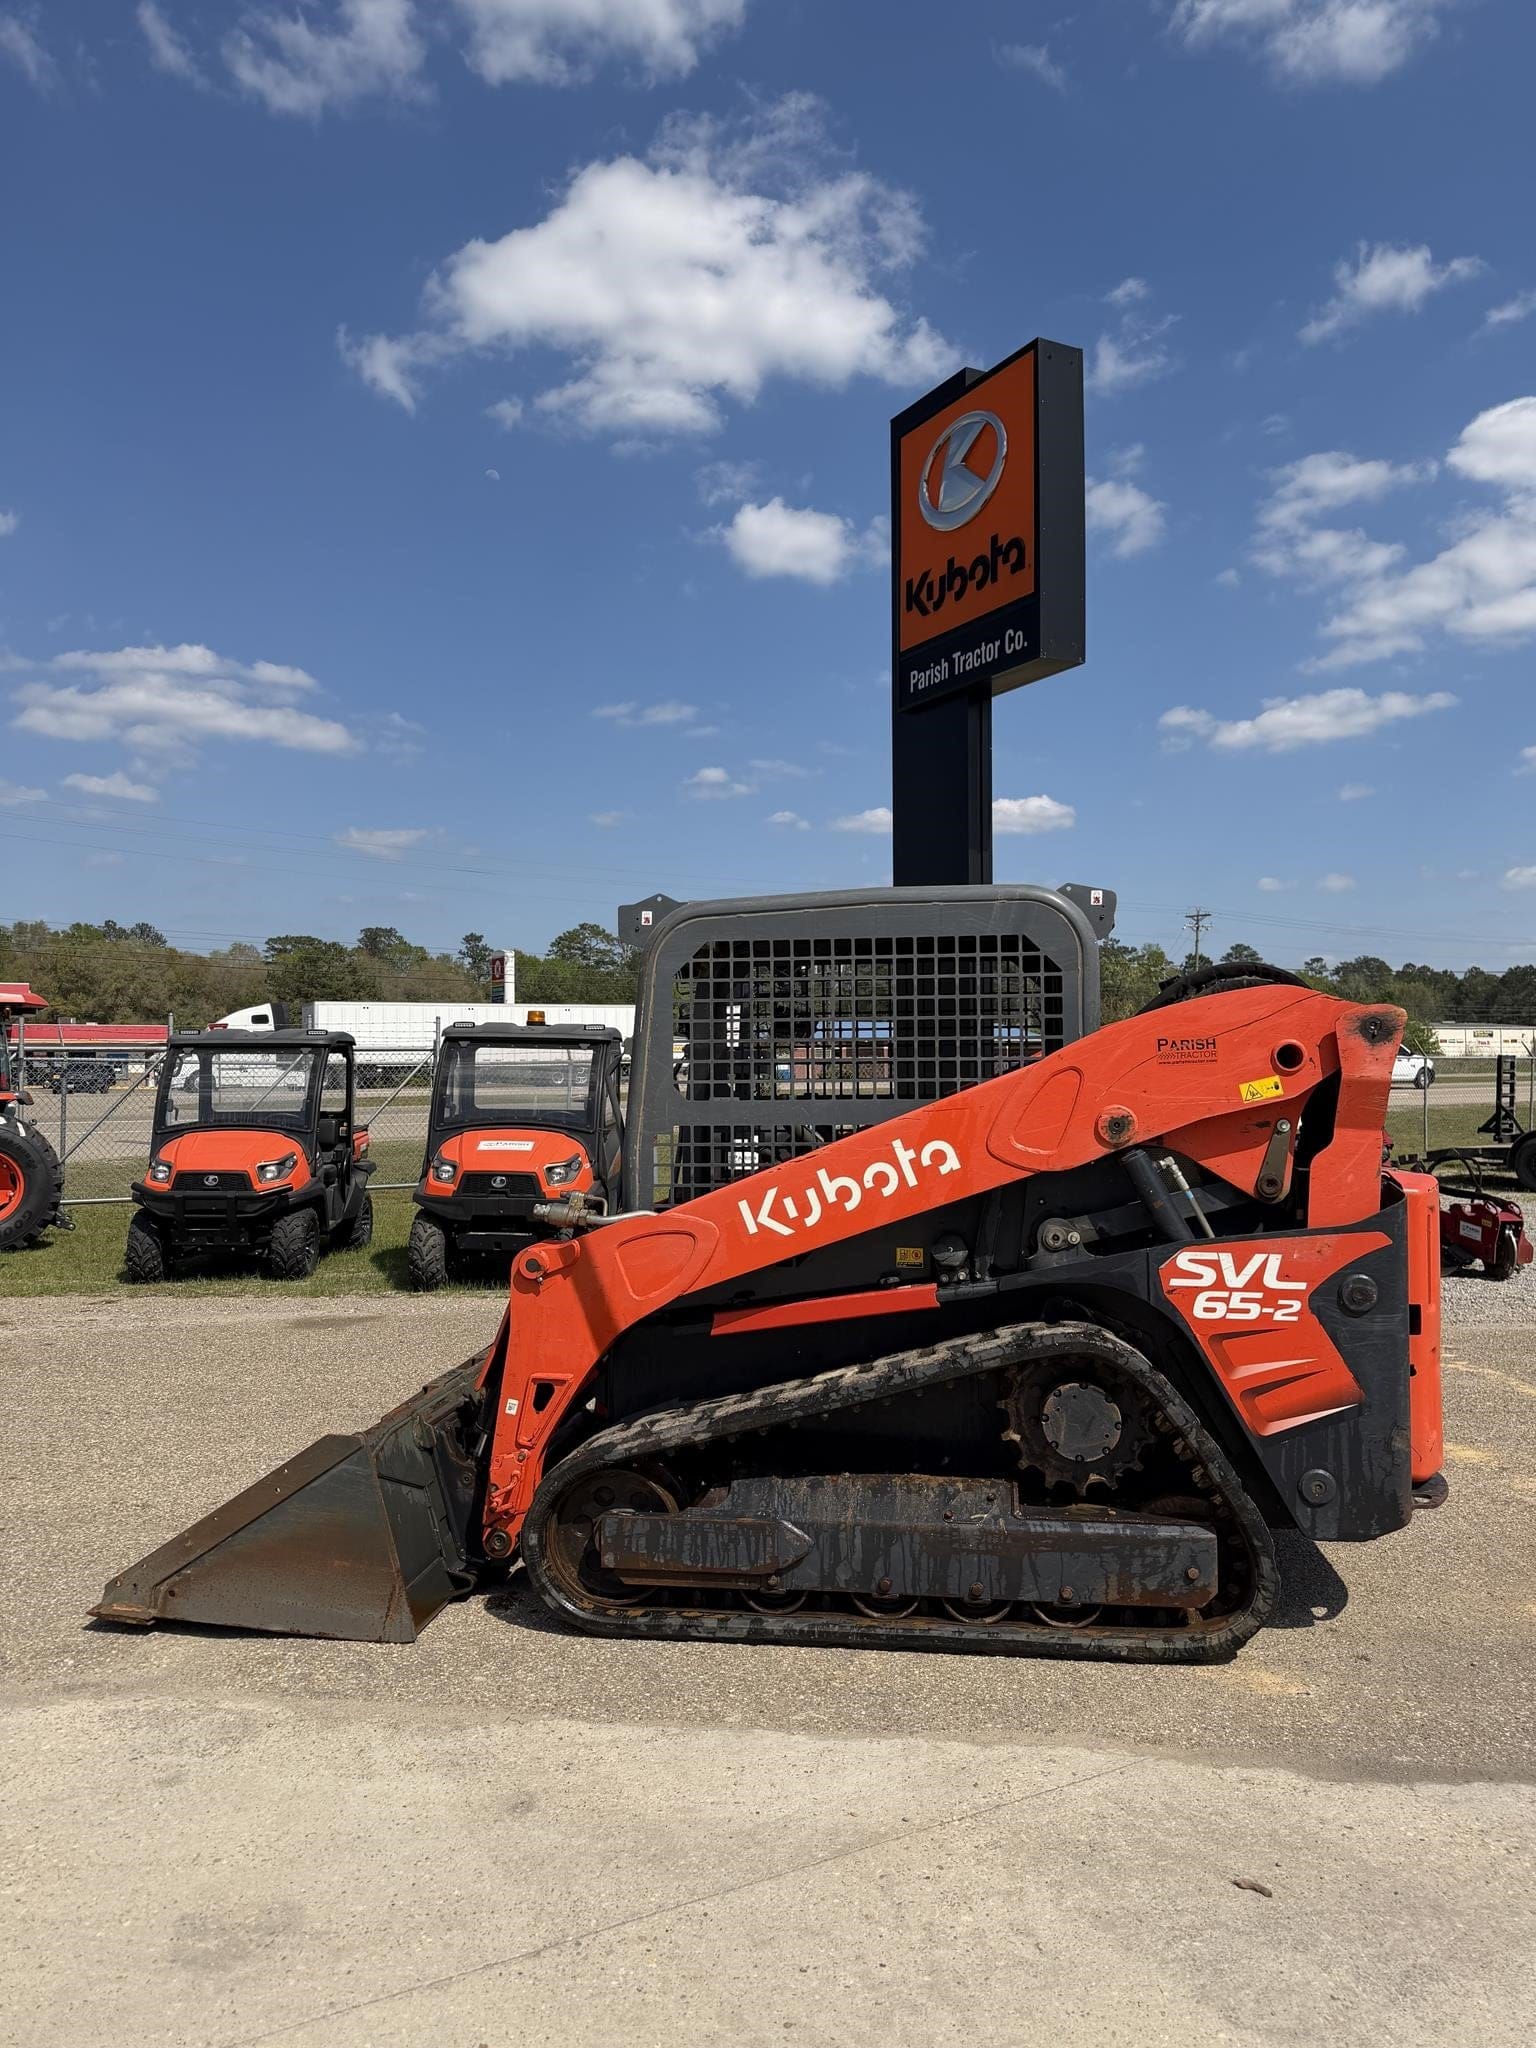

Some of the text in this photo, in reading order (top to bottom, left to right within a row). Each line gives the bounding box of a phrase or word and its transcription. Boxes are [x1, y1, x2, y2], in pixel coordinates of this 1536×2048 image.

[906, 533, 1026, 617] Kubota
[910, 628, 1028, 694] Parish Tractor Co.
[1175, 1050, 1218, 1060] TRACTOR
[737, 1138, 962, 1237] Kubota
[1168, 1251, 1308, 1290] SVL
[1192, 1290, 1302, 1322] 65-2
